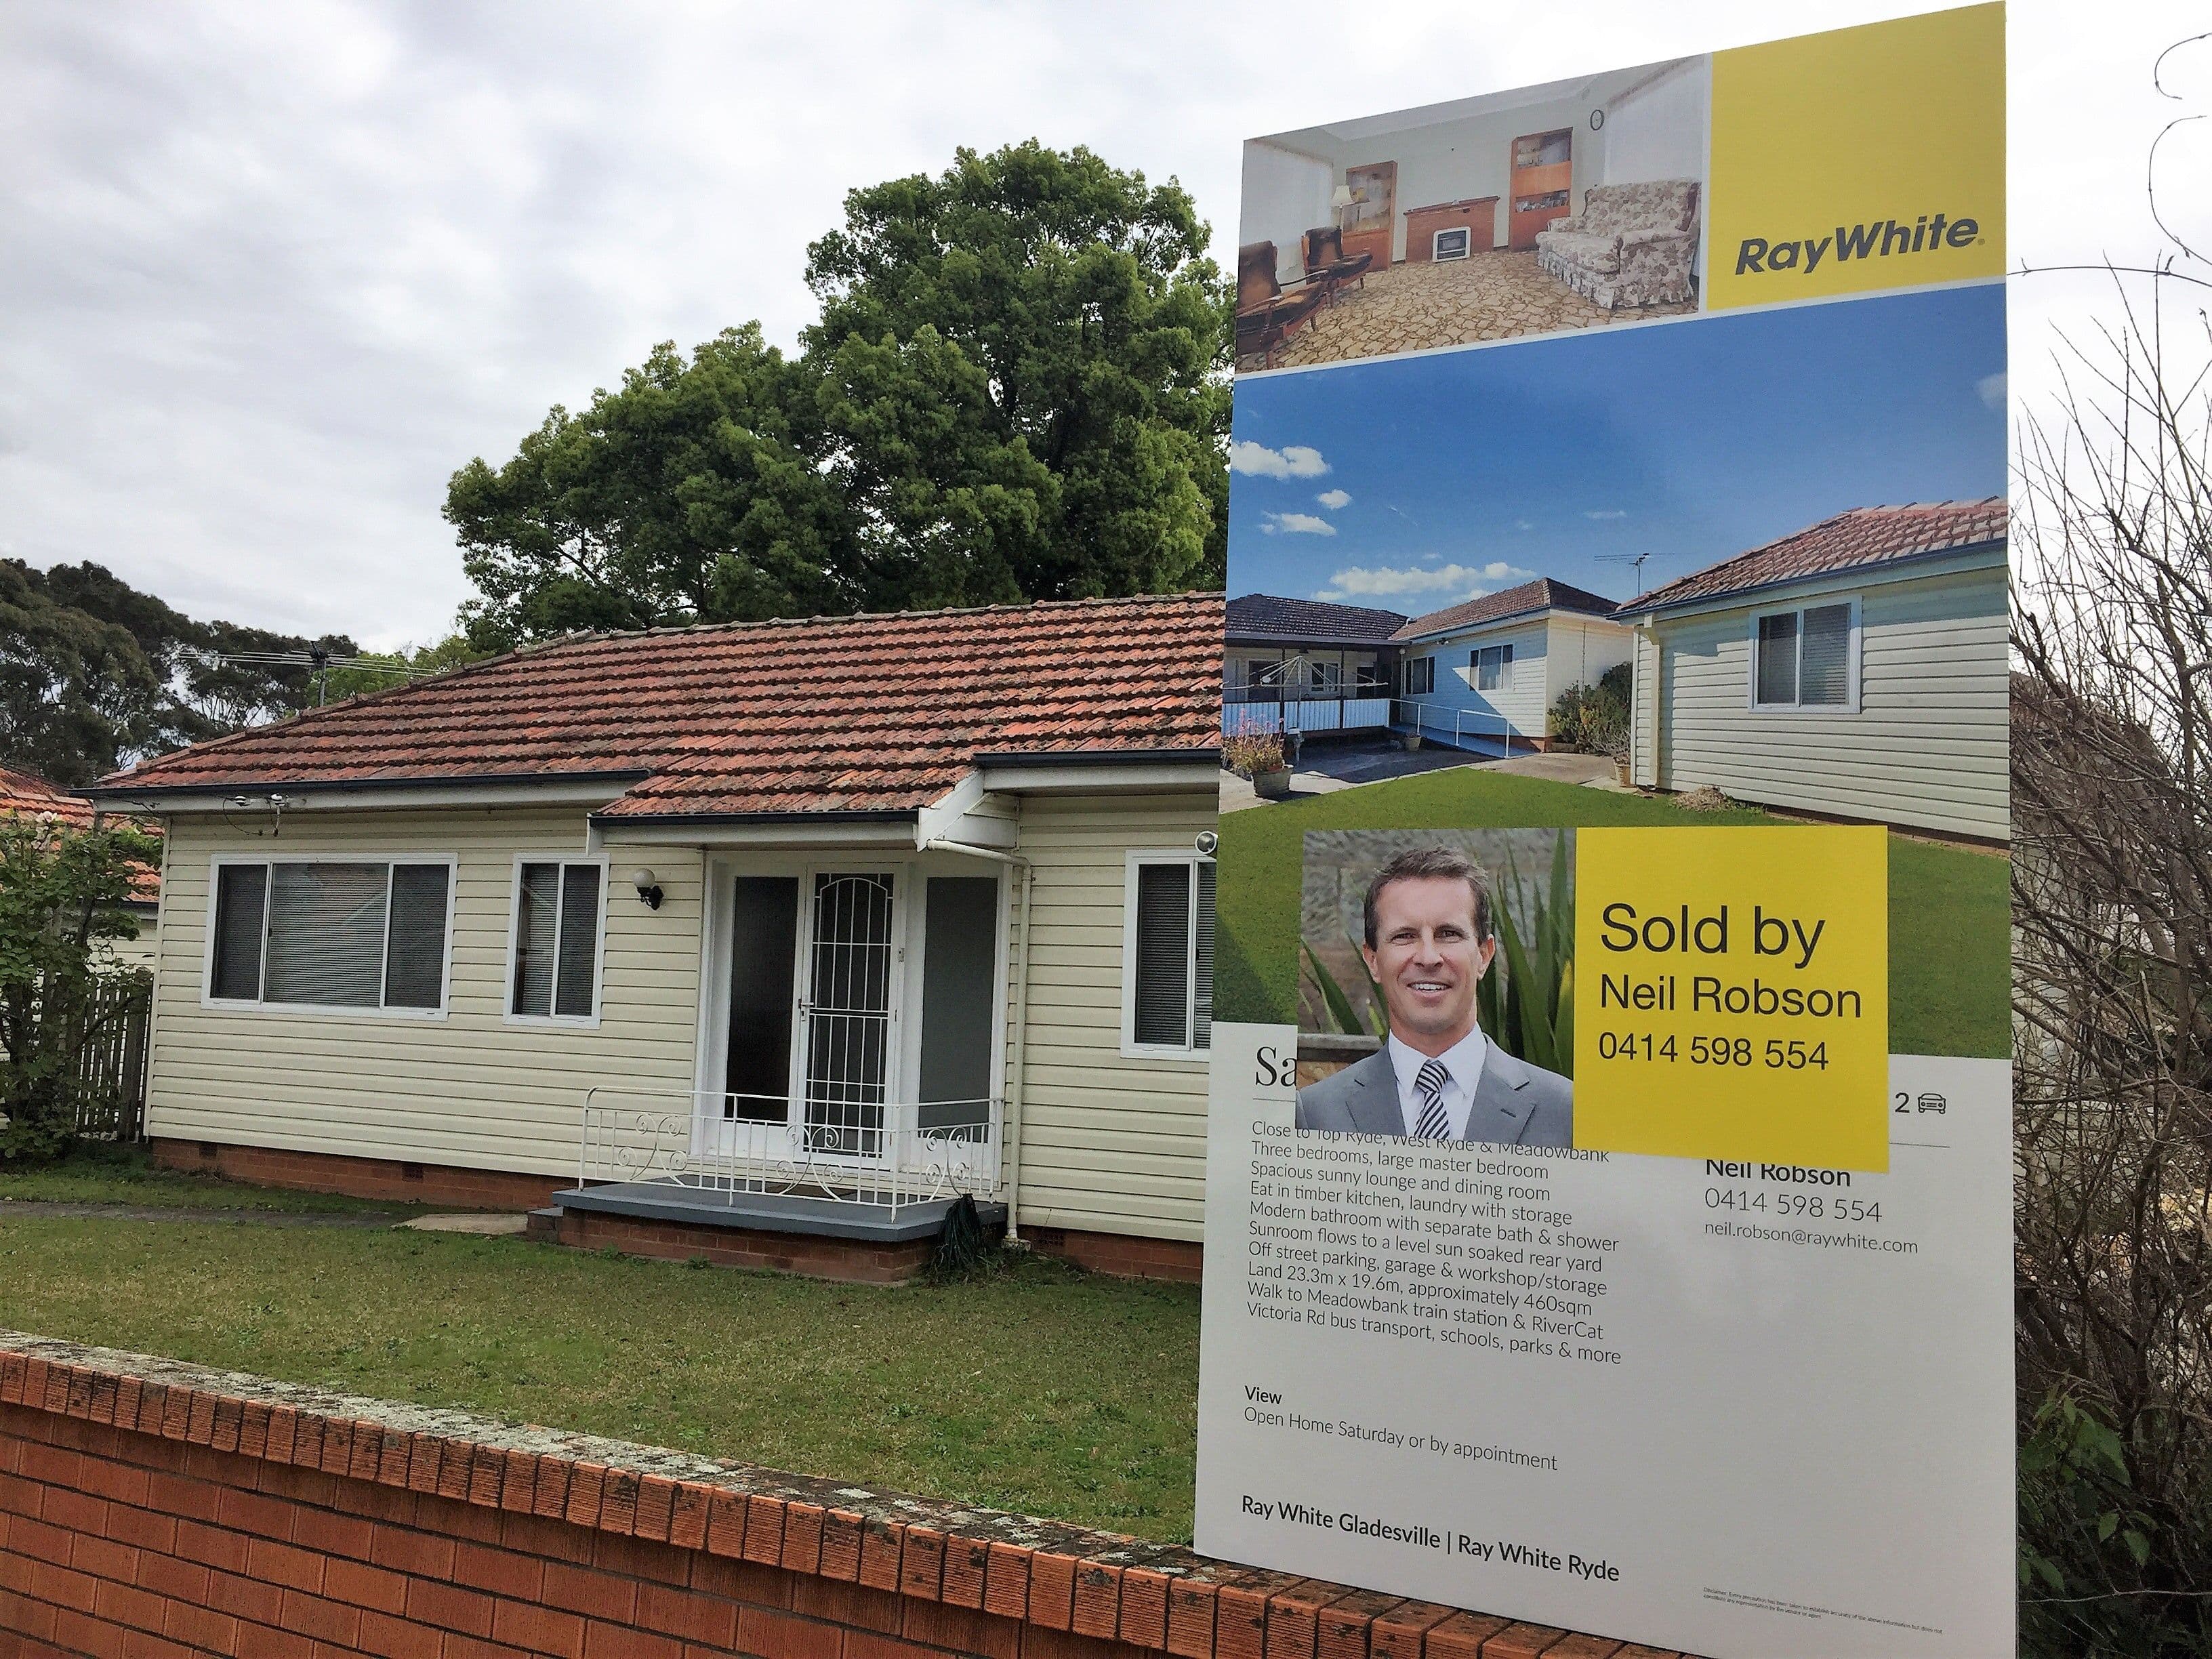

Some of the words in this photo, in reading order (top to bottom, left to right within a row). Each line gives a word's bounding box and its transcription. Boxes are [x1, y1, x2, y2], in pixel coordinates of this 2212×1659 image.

[1735, 213, 1979, 275] RayWhite
[1601, 903, 1728, 954] Sold
[1754, 905, 1826, 970] by
[1601, 973, 1675, 1011] Neil
[1693, 976, 1861, 1019] Robson
[1599, 1031, 1679, 1063] 0414
[1690, 1036, 1753, 1067] 598
[1765, 1040, 1829, 1071] 554
[1894, 1092, 1910, 1113] 2
[1252, 1121, 1292, 1137] Close
[1296, 1128, 1310, 1139] to
[1392, 1135, 1431, 1148] West
[1250, 1160, 1313, 1180] Spacious
[1317, 1170, 1362, 1187] sunny
[1366, 1169, 1416, 1192] lounge
[1421, 1176, 1450, 1192] and
[1454, 1178, 1503, 1200] dining
[1509, 1186, 1551, 1202] room
[1251, 1140, 1292, 1158] Three
[1296, 1143, 1373, 1167] bedrooms,
[1378, 1150, 1414, 1170] large
[1419, 1157, 1473, 1172] master
[1477, 1158, 1549, 1180] bedroom
[1706, 1160, 1752, 1179] Neil
[1761, 1163, 1851, 1187] Robson
[1250, 1200, 1306, 1220] Modern
[1311, 1206, 1382, 1227] bathroom
[1386, 1214, 1419, 1231] with
[1425, 1221, 1492, 1239] separate
[1497, 1224, 1532, 1243] bath
[1538, 1229, 1552, 1246] &
[1557, 1231, 1620, 1252] shower
[1251, 1180, 1273, 1197] Eat
[1277, 1183, 1290, 1198] in
[1294, 1185, 1343, 1203] timber
[1346, 1188, 1404, 1211] kitchen,
[1410, 1194, 1468, 1218] laundry
[1471, 1202, 1506, 1219] with
[1511, 1206, 1572, 1228] storage
[1704, 1187, 1768, 1212] 0414
[1777, 1193, 1824, 1218] 598
[1834, 1198, 1883, 1223] 554
[1249, 1220, 1313, 1242] Sunroom
[1317, 1227, 1357, 1246] flows
[1361, 1233, 1377, 1248] to
[1382, 1237, 1390, 1250] a
[1395, 1235, 1430, 1254] level
[1435, 1244, 1462, 1257] sun
[1468, 1245, 1523, 1264] soaked
[1530, 1253, 1562, 1268] rear
[1565, 1256, 1602, 1273] yard
[1705, 1221, 1918, 1254] neil.robson@raywhite.com
[1248, 1241, 1273, 1257] Off
[1276, 1245, 1318, 1263] street
[1322, 1250, 1380, 1273] parking,
[1385, 1259, 1436, 1278] garage
[1441, 1262, 1454, 1278] &
[1458, 1266, 1607, 1298] workshop/storage
[1248, 1261, 1282, 1279] Land
[1287, 1265, 1334, 1285] 23.3m
[1338, 1275, 1347, 1286] x
[1352, 1273, 1404, 1295] 19.6m,
[1408, 1283, 1520, 1310] approximately
[1523, 1293, 1592, 1317] 460sqm
[1246, 1300, 1301, 1323] Victoria
[1307, 1309, 1326, 1326] Rd
[1330, 1311, 1357, 1330] bus
[1361, 1316, 1435, 1343] transport,
[1440, 1328, 1504, 1351] schools,
[1509, 1337, 1553, 1355] parks
[1558, 1341, 1572, 1359] &
[1578, 1347, 1621, 1365] more
[1247, 1281, 1283, 1300] Walk
[1287, 1286, 1303, 1302] to
[1307, 1288, 1408, 1315] Meadowbank
[1412, 1301, 1448, 1320] train
[1453, 1307, 1507, 1328] station
[1513, 1313, 1526, 1330] &
[1532, 1315, 1604, 1340] RiverCat
[1244, 1385, 1283, 1405] View
[1244, 1406, 1284, 1427] Open
[1289, 1413, 1334, 1434] Home
[1338, 1420, 1405, 1449] Saturday
[1409, 1436, 1426, 1449] or
[1430, 1434, 1450, 1456] by
[1453, 1443, 1558, 1471] appointment
[1242, 1494, 1274, 1521] Ray
[1277, 1500, 1334, 1528] White
[1338, 1513, 1441, 1549] Gladesville
[1458, 1534, 1494, 1562] Ray
[1498, 1541, 1561, 1571] White
[1568, 1554, 1620, 1582] Ryde
